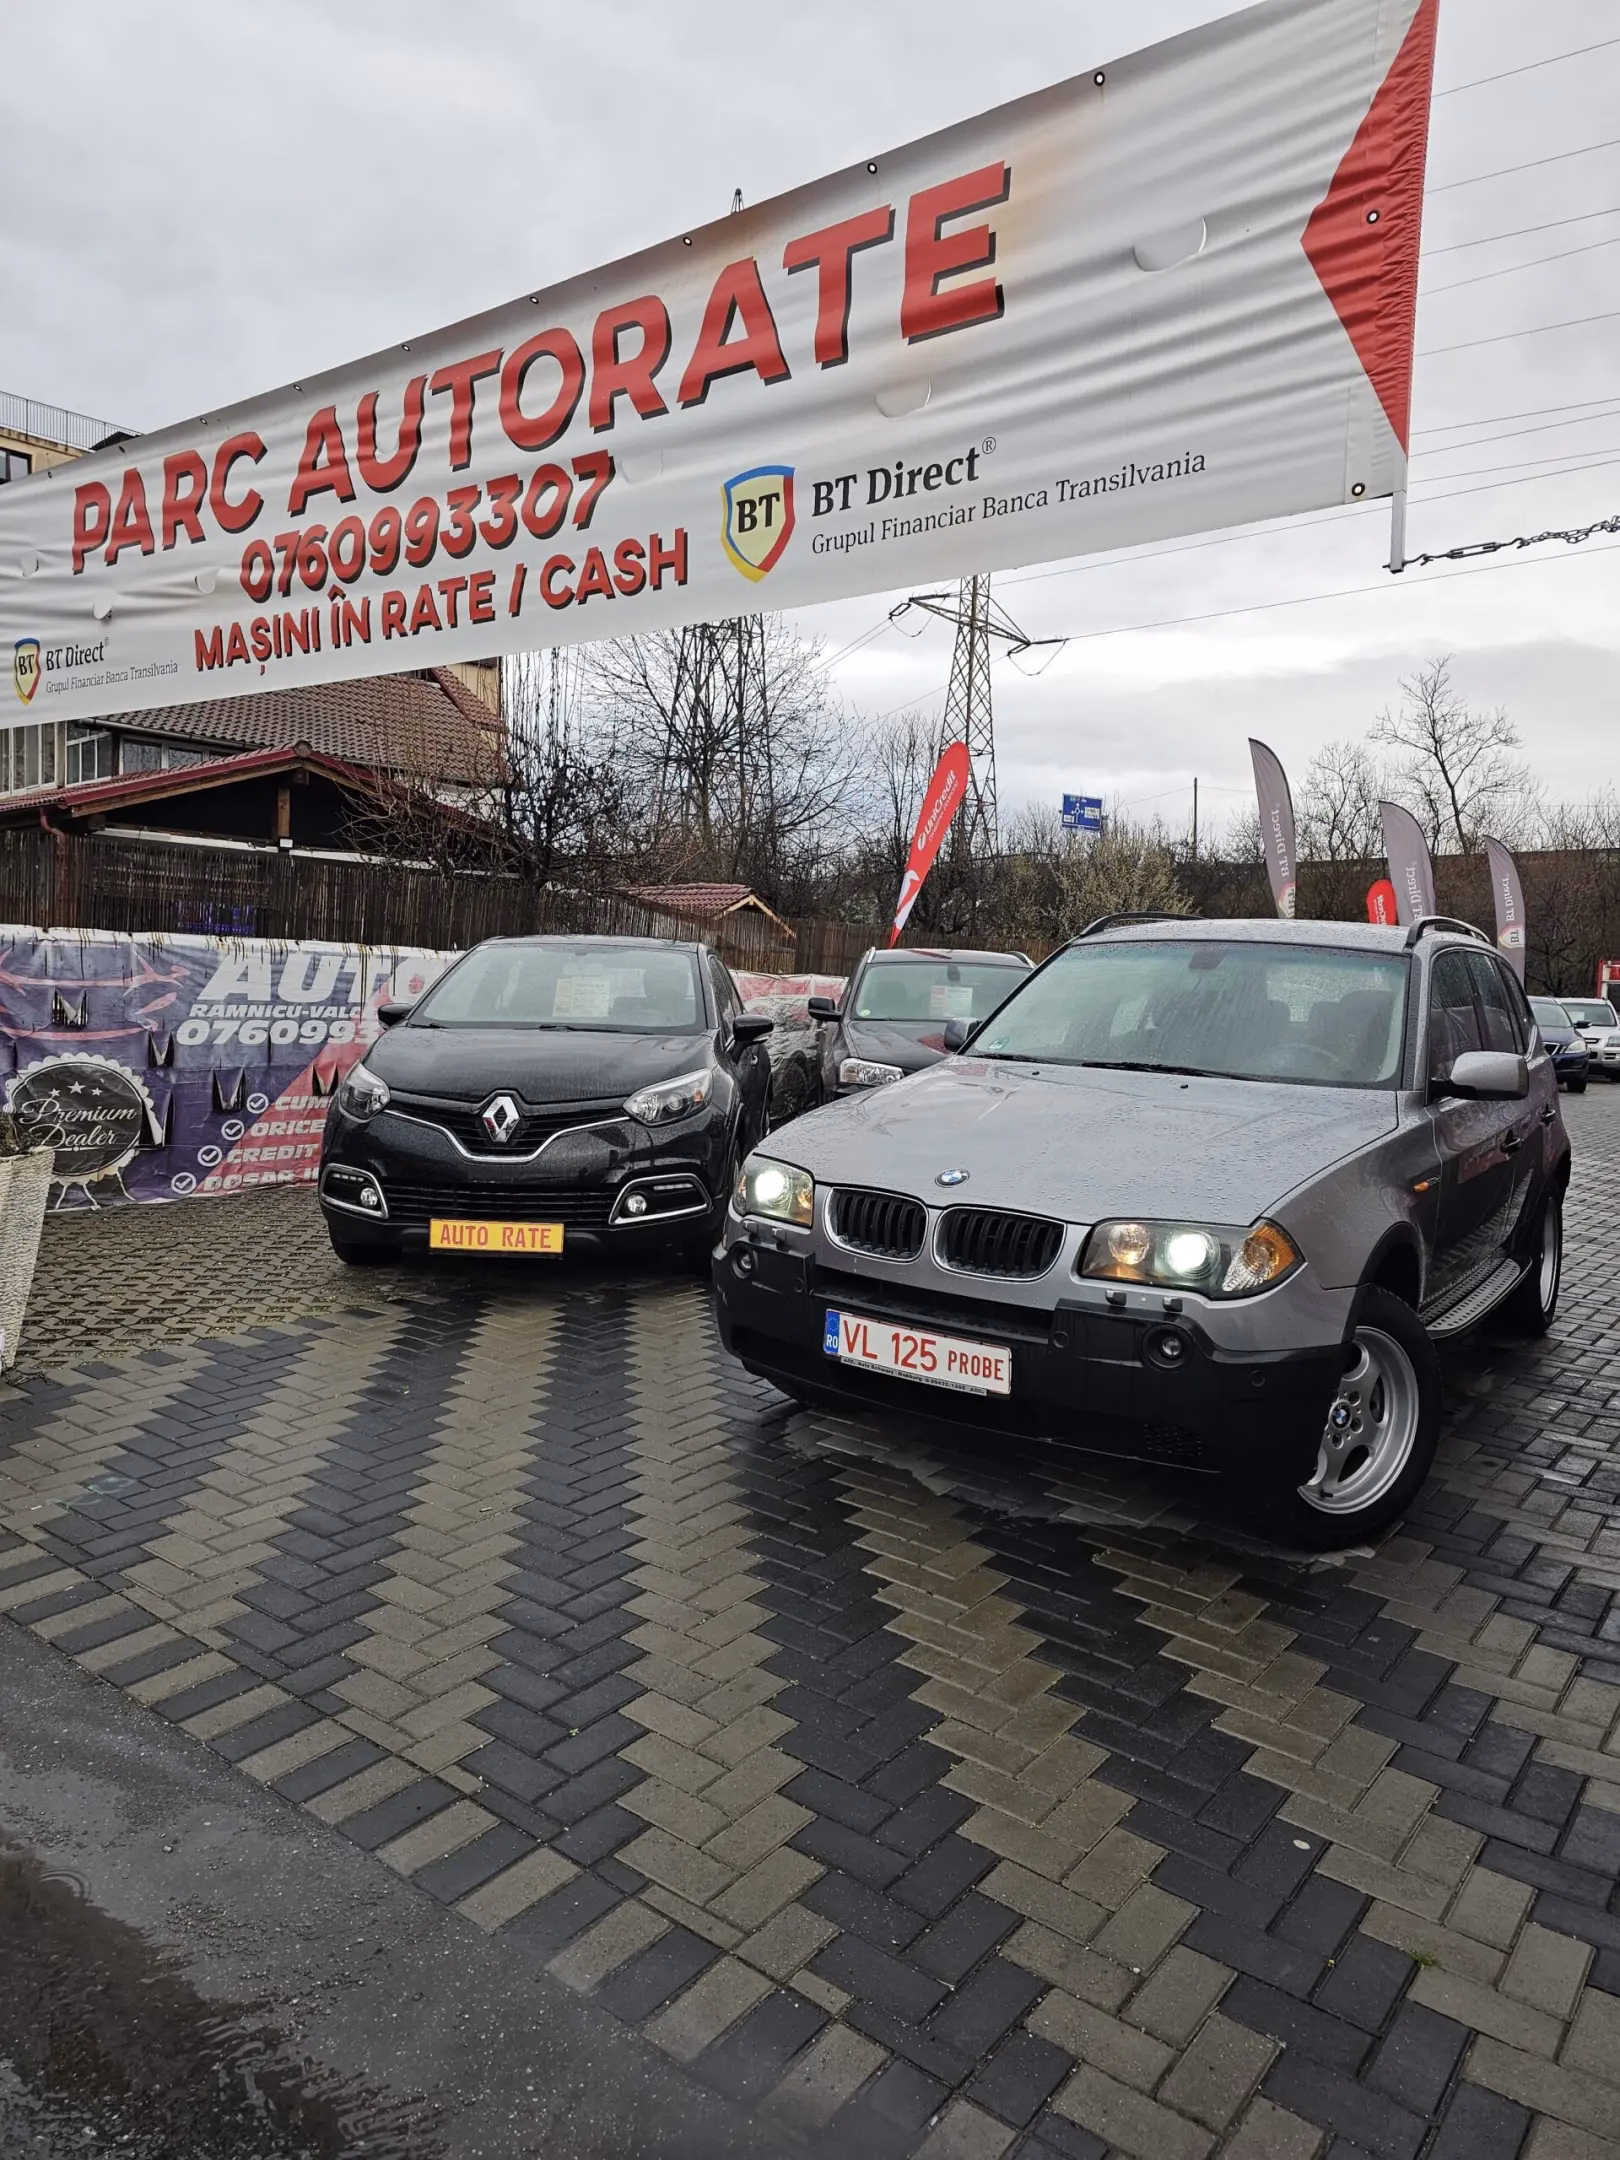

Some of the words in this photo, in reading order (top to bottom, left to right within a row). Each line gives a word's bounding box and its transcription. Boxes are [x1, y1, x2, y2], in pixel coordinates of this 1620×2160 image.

[72, 431, 268, 575] PARC
[288, 160, 1011, 516] AUTORATE
[812, 474, 857, 517] BT
[812, 523, 875, 555] Grupul
[881, 504, 976, 540] Financiar
[982, 490, 1049, 520] Banca
[1056, 451, 1206, 503] Transilvania
[240, 449, 617, 602] 0760993307
[736, 492, 780, 533] BT
[195, 610, 321, 675] MAȘINI
[331, 584, 372, 646] ÎN
[381, 569, 496, 639] RATE
[508, 562, 527, 614] /
[539, 527, 688, 609] CASH
[18, 654, 34, 676] BT
[46, 649, 62, 671] BT
[46, 677, 69, 694] Grupul
[71, 674, 104, 690] Financiar
[106, 671, 128, 684] Banca
[130, 660, 178, 677] Transilvania
[924, 769, 956, 835] UniCredit
[19, 1096, 137, 1124] Premium
[275, 1096, 334, 1111] CUM
[28, 1122, 118, 1148] Dealer
[227, 1144, 319, 1164] CREDIT
[204, 1169, 294, 1191] DOSAR
[440, 1223, 489, 1247] AUTO
[502, 1226, 551, 1249] RATE
[826, 1334, 838, 1348] RO
[843, 1320, 878, 1360] VL
[892, 1332, 938, 1372] 125
[948, 1350, 1005, 1381] PROBE
